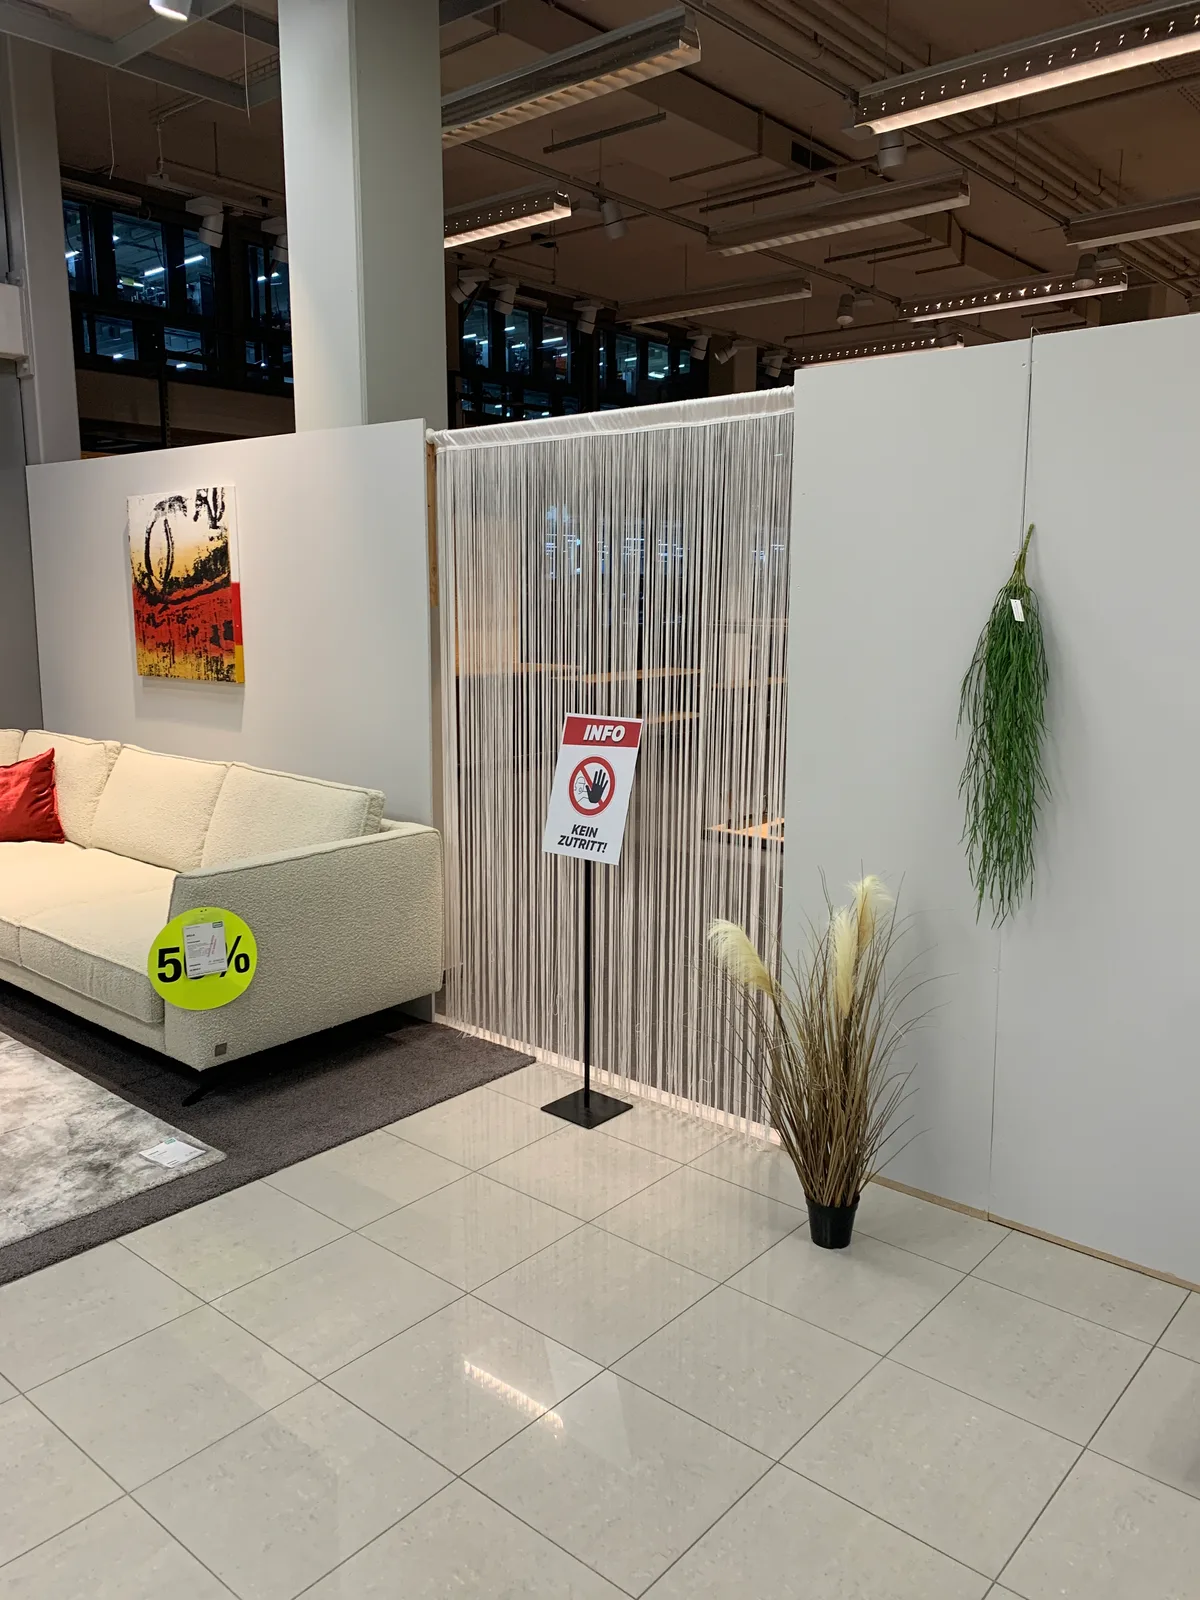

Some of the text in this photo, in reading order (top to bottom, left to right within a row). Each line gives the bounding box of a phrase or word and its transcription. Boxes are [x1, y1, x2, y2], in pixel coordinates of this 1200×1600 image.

[583, 724, 626, 743] INFO
[571, 824, 599, 838] KEIN
[557, 835, 608, 854] ZUTRITT!
[157, 935, 251, 983] 5%
